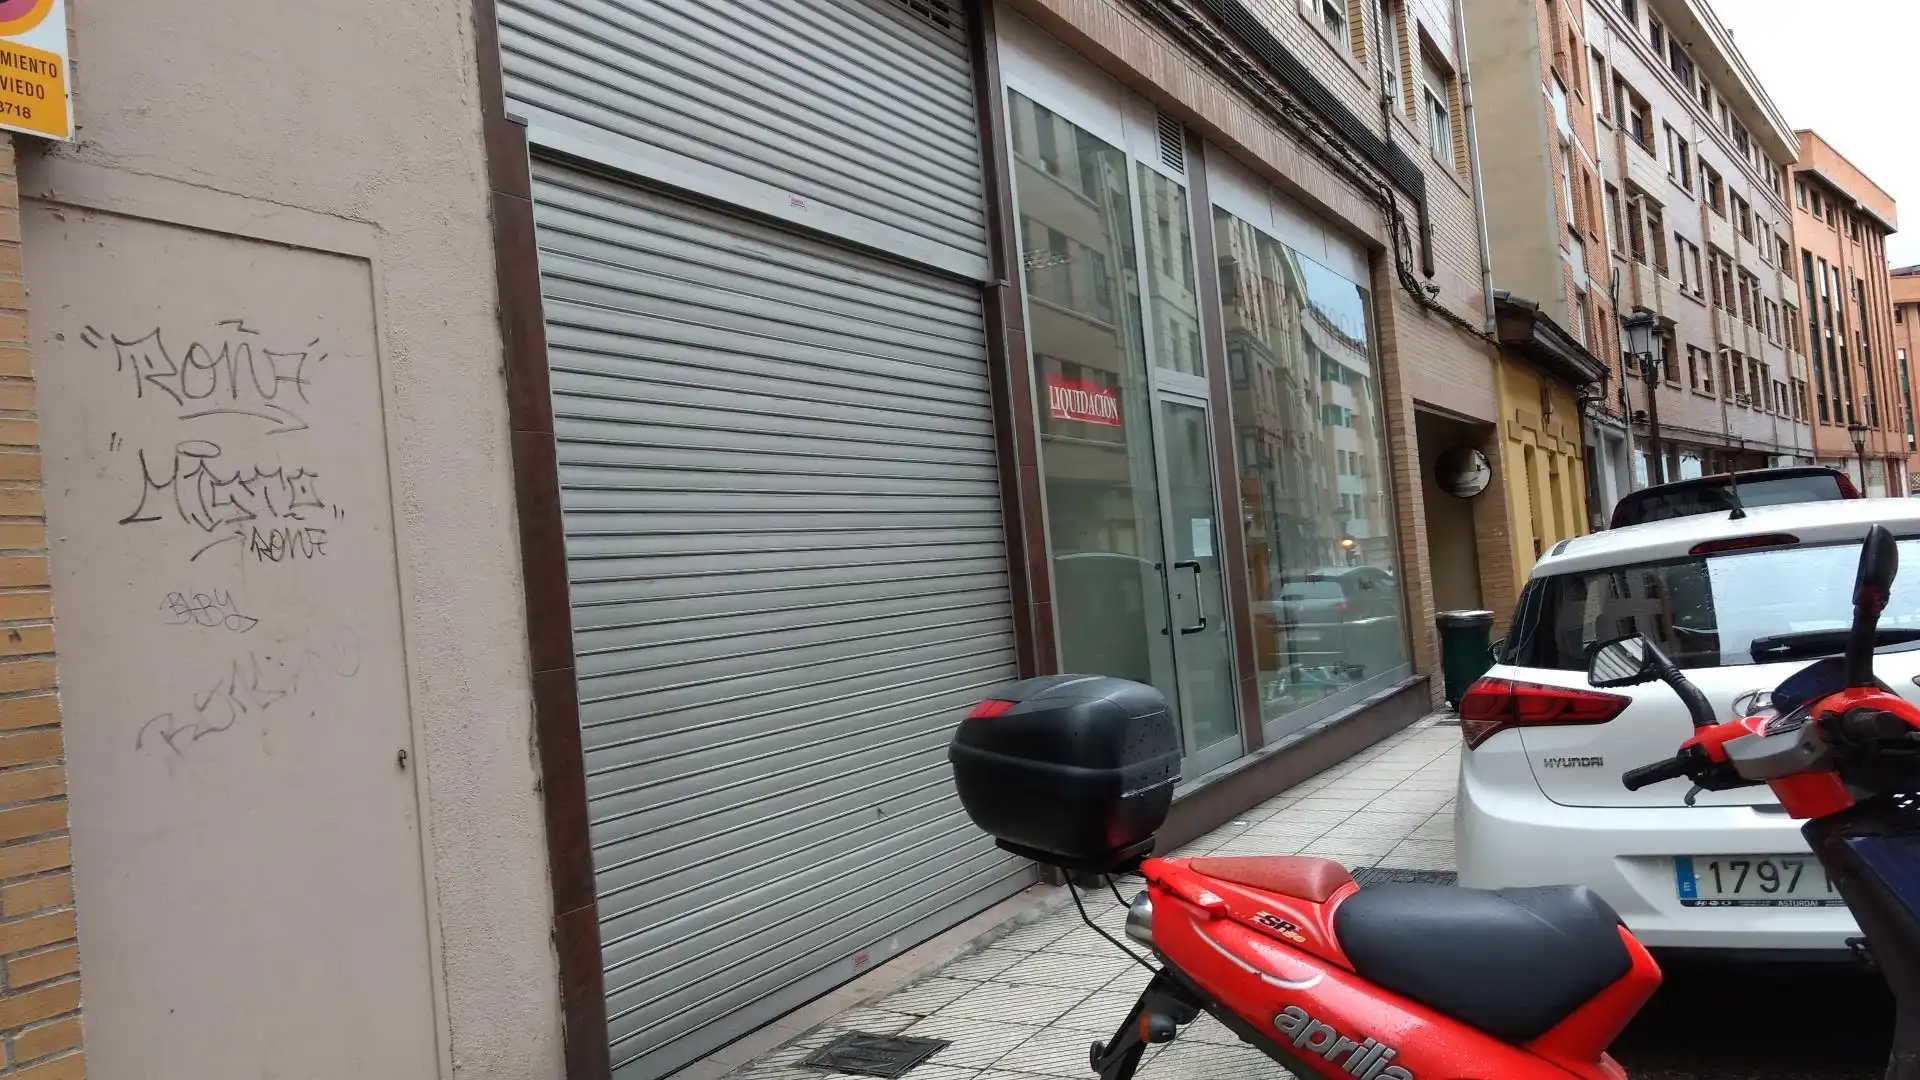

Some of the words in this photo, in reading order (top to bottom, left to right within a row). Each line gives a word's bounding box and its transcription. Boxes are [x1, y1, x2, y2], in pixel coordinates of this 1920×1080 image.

[1048, 385, 1119, 420] LIQUIDACIÓN
[1543, 756, 1604, 768] HYUNDAI
[1683, 881, 1692, 892] E
[1708, 860, 1804, 894] 1797
[1259, 914, 1297, 933] SR
